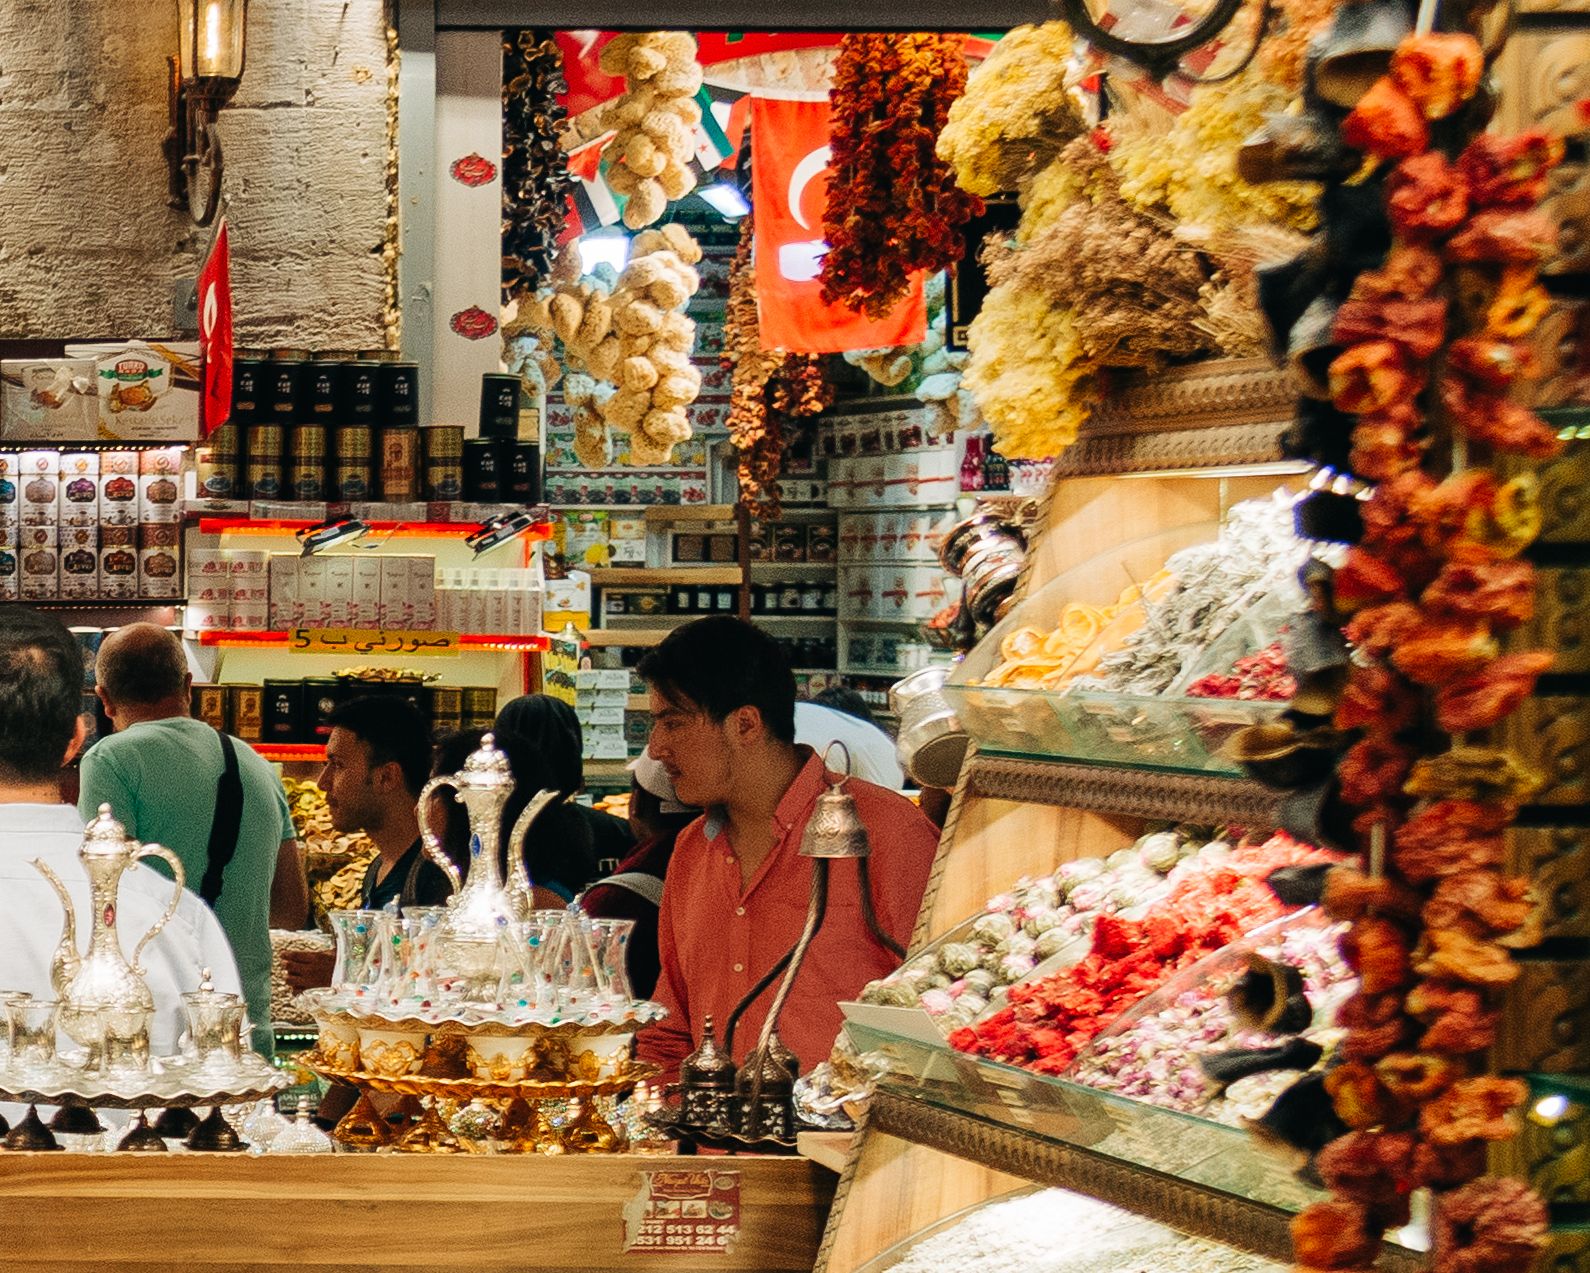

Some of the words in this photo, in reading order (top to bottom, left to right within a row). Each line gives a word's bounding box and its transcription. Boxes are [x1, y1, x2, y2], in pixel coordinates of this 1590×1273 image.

[294, 629, 311, 648] 5
[665, 1224, 693, 1234] 513
[695, 1224, 714, 1234] 62
[716, 1224, 737, 1234] 44
[665, 1235, 692, 1245] 951
[694, 1235, 715, 1245] 24
